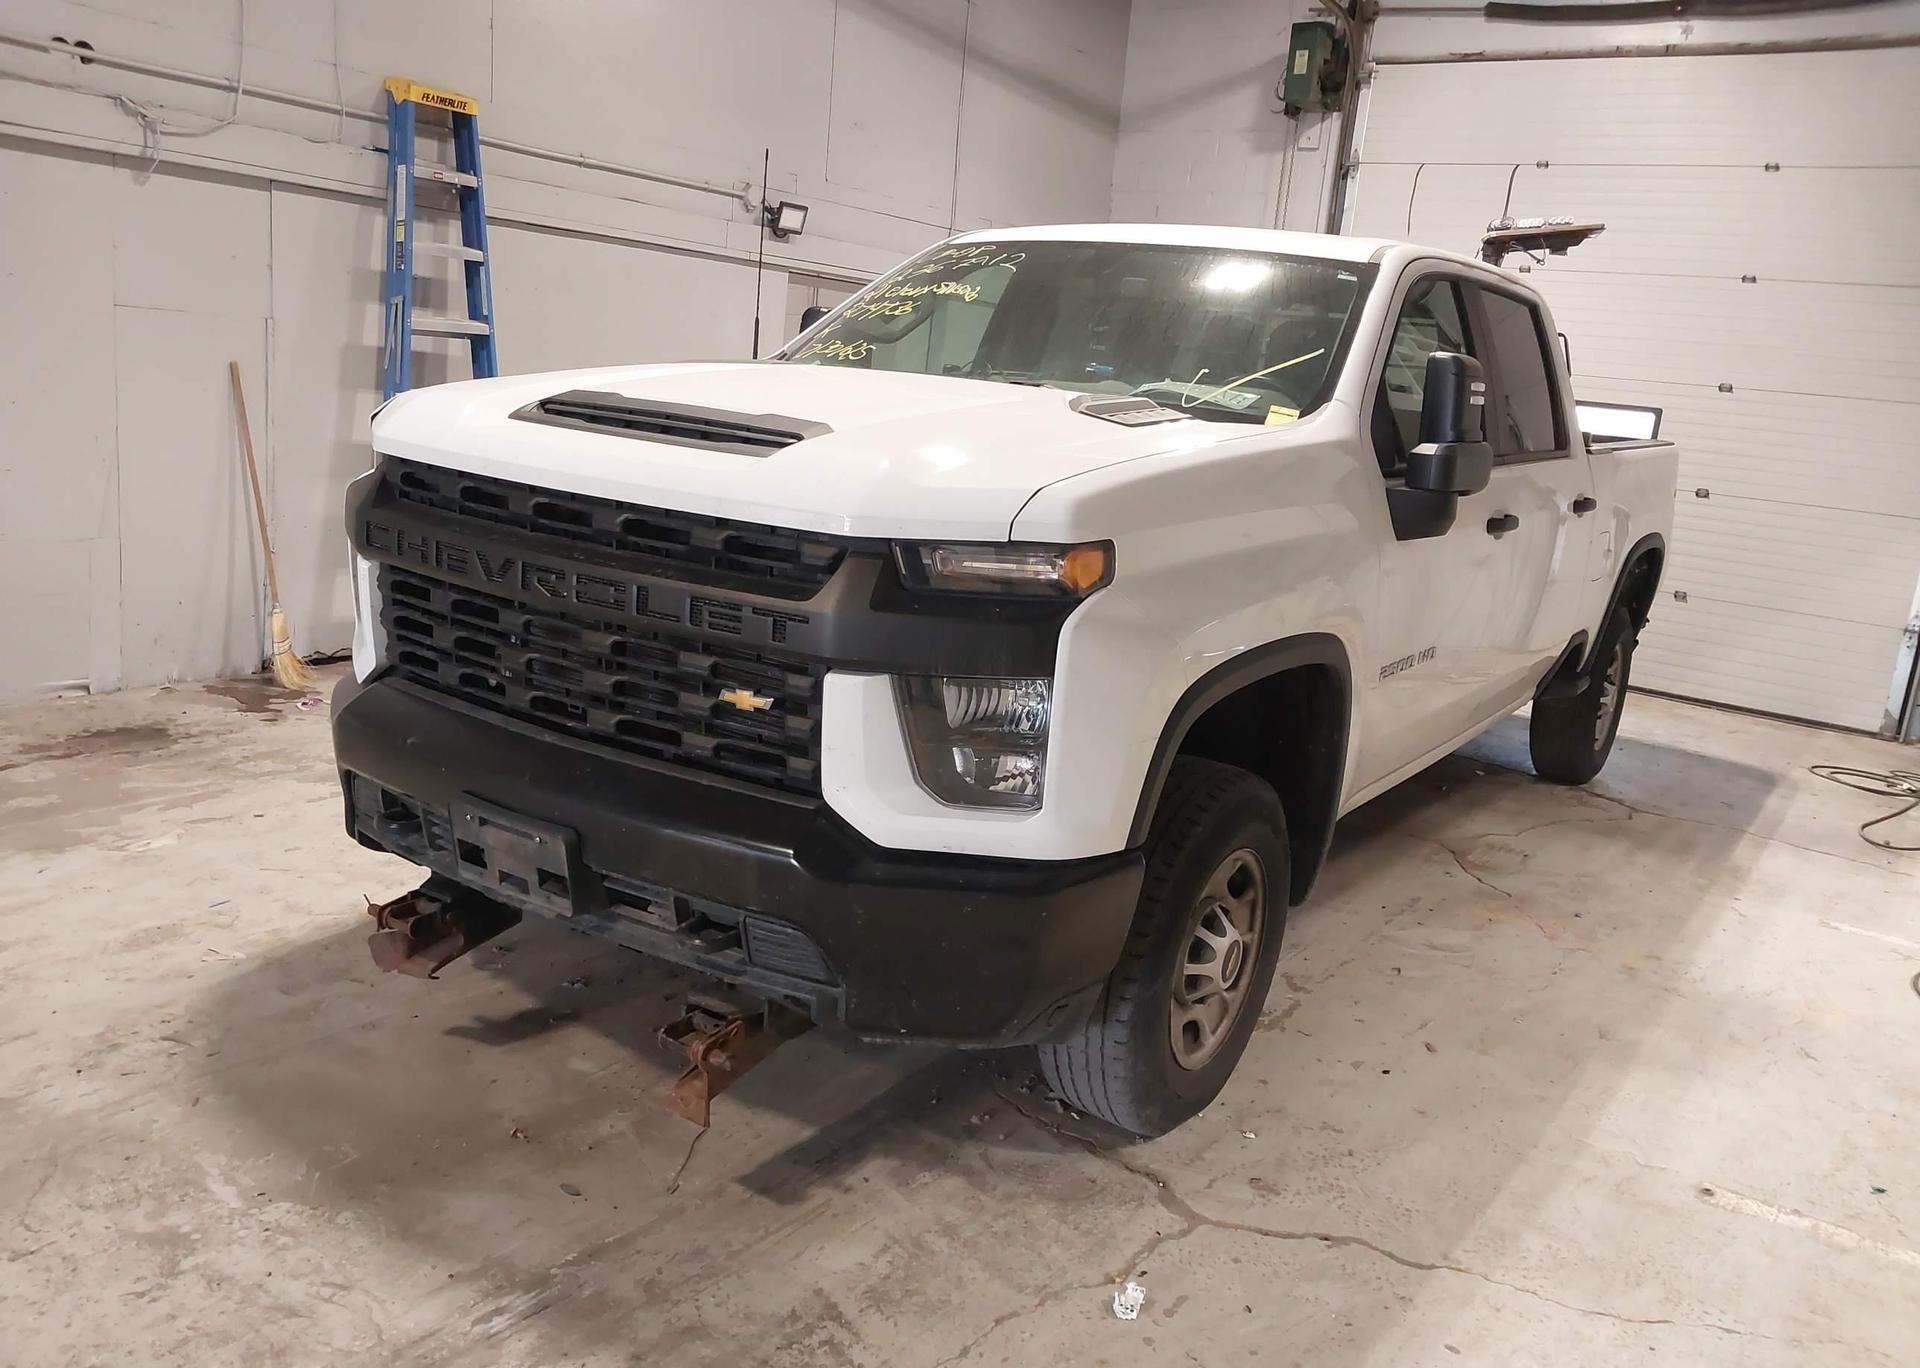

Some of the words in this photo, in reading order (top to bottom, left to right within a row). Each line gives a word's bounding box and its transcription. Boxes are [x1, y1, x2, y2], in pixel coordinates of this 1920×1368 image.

[421, 92, 468, 111] FEATHERLITE
[365, 520, 810, 643] CHEVROLET
[1417, 646, 1437, 665] HD
